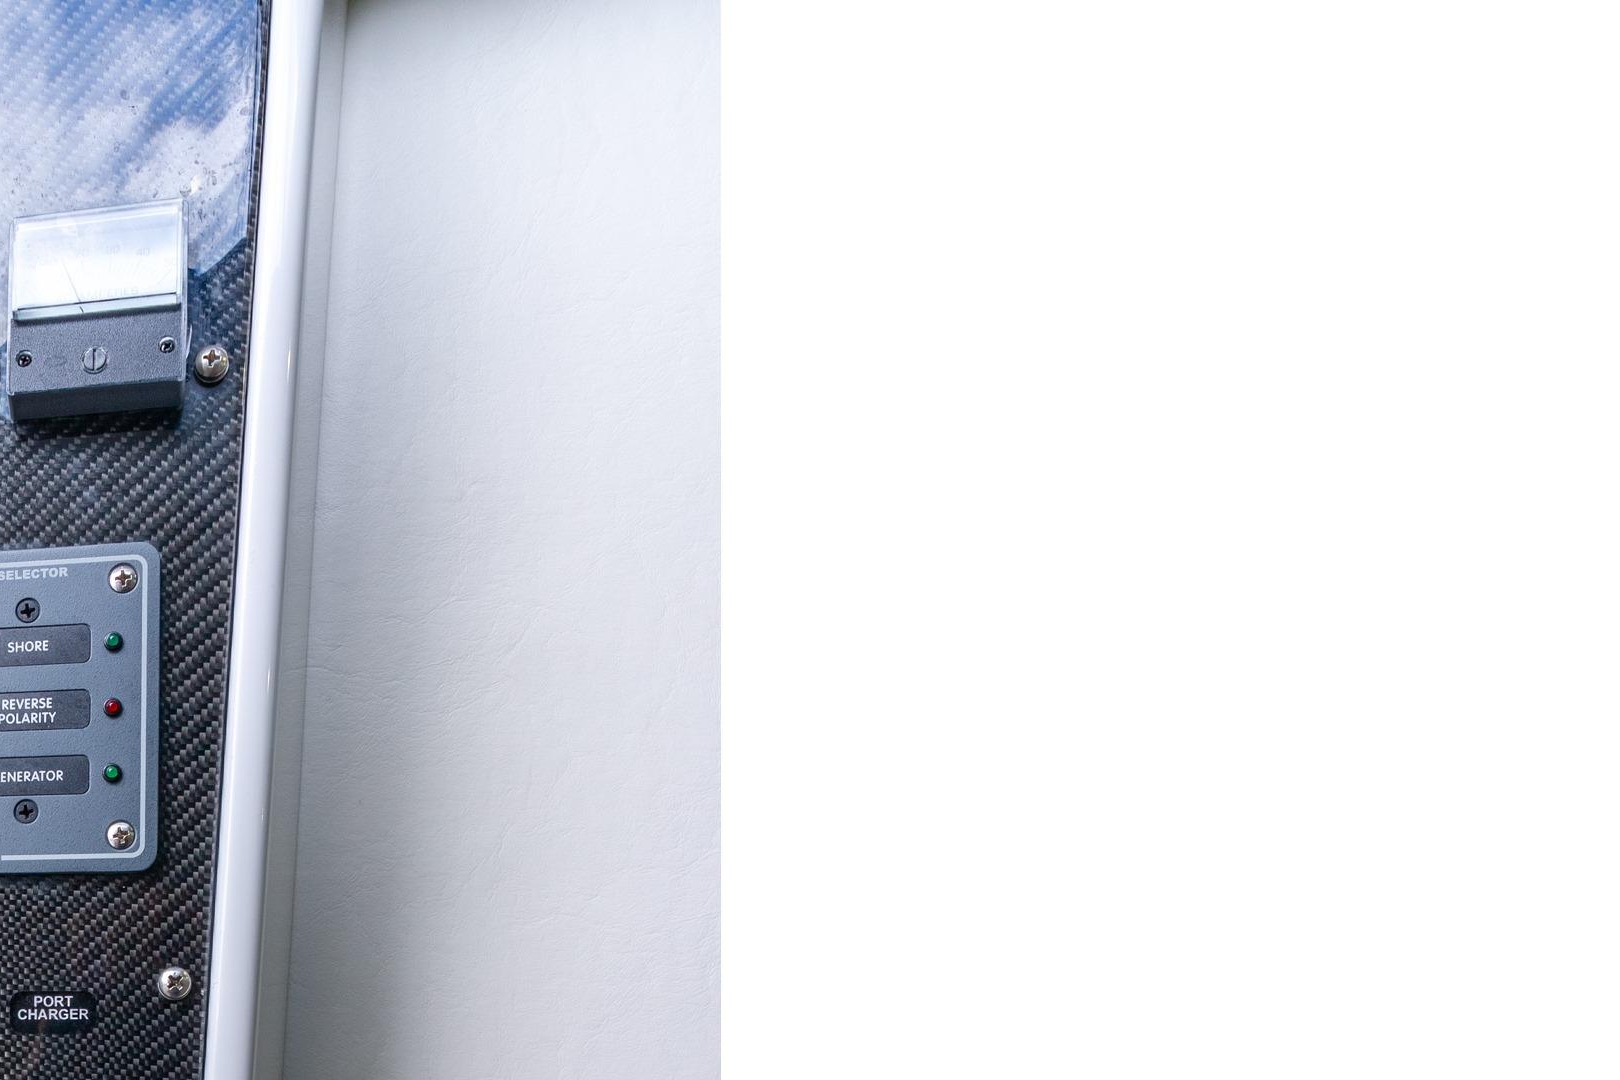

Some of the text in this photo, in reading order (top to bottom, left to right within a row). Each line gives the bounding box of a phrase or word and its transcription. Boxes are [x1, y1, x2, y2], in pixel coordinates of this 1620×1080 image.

[7, 640, 50, 653] SHORE
[2, 698, 53, 711] REVERSE
[33, 995, 73, 1008] PORT
[17, 1008, 89, 1021] CHARGER
